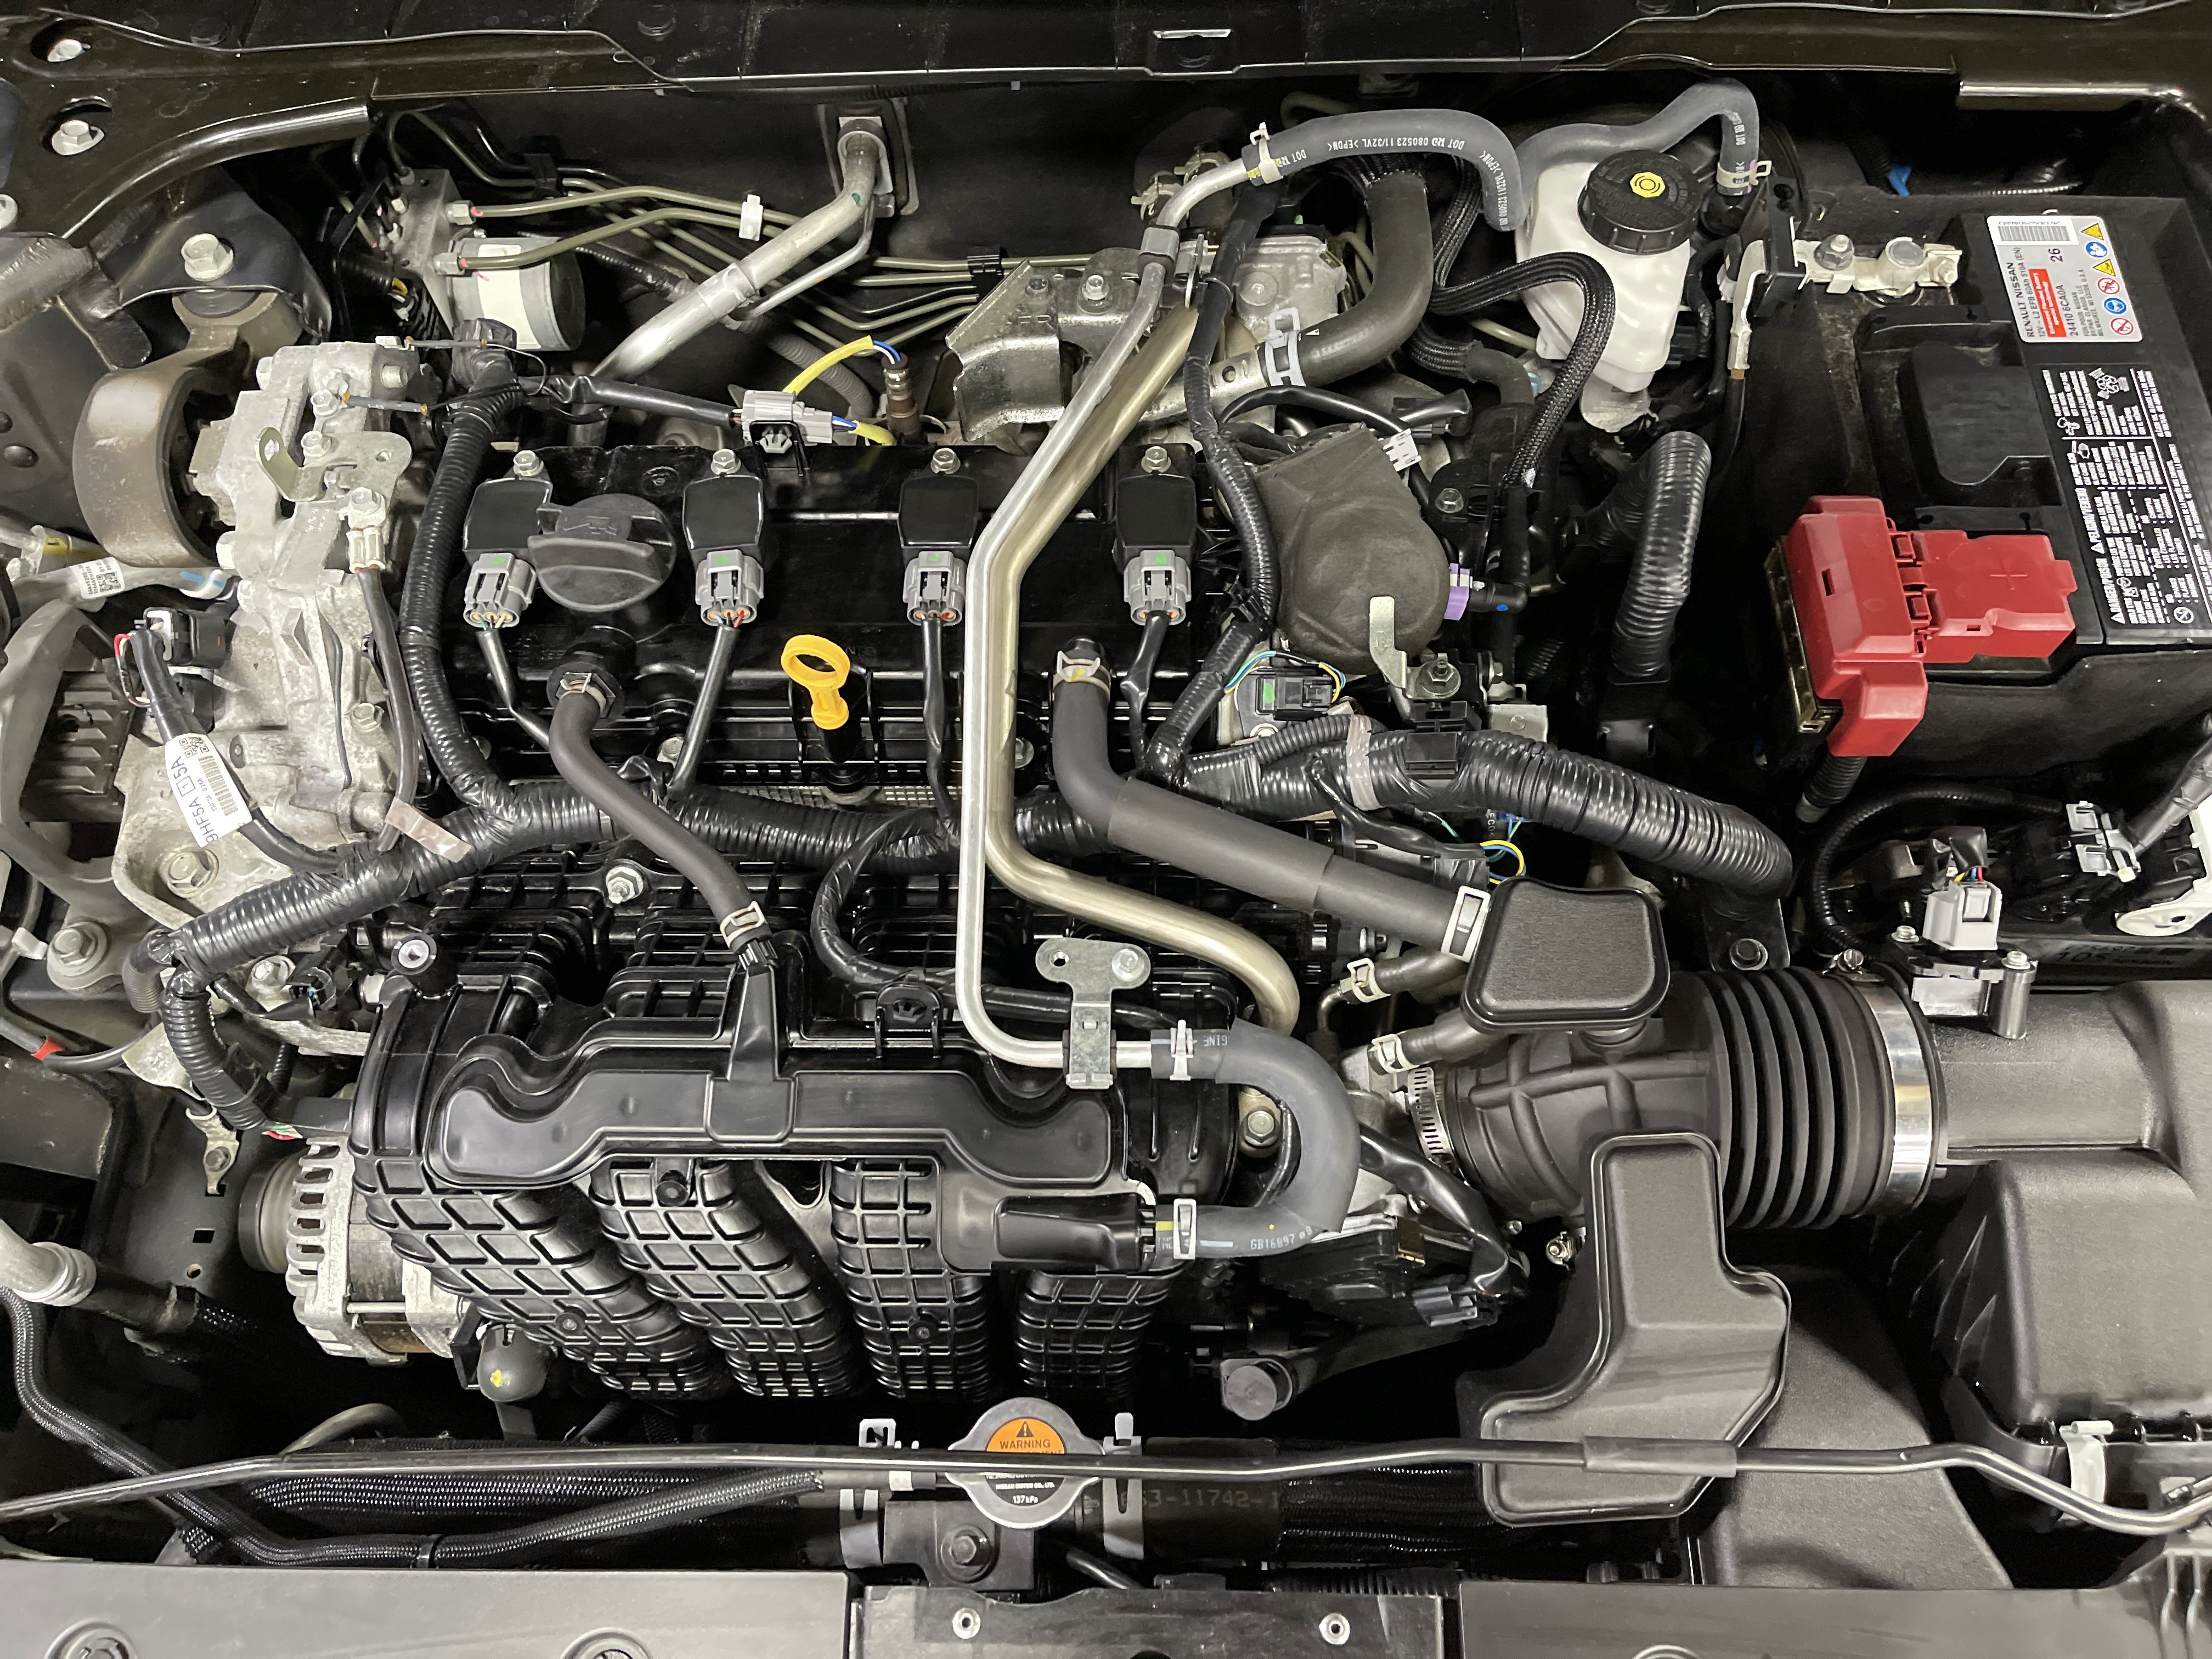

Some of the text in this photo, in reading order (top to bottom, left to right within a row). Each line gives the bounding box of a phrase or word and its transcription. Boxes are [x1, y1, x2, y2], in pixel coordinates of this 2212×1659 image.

[1397, 137, 1429, 146] 080523
[1447, 138, 1465, 150] DOT
[1291, 149, 1307, 163] DOT
[2012, 247, 2024, 260] (EN)
[2046, 247, 2063, 262] 26
[2017, 262, 2028, 276] 510A
[2005, 262, 2035, 337] RENAULT NISSAN
[2055, 284, 2079, 336] 24410 6CA0A
[2035, 326, 2046, 336] 12V
[2074, 487, 2102, 543] PELIGRO/VENENO
[2095, 558, 2122, 612] DANGER/POISON
[1000, 1438, 1051, 1449] WARNING
